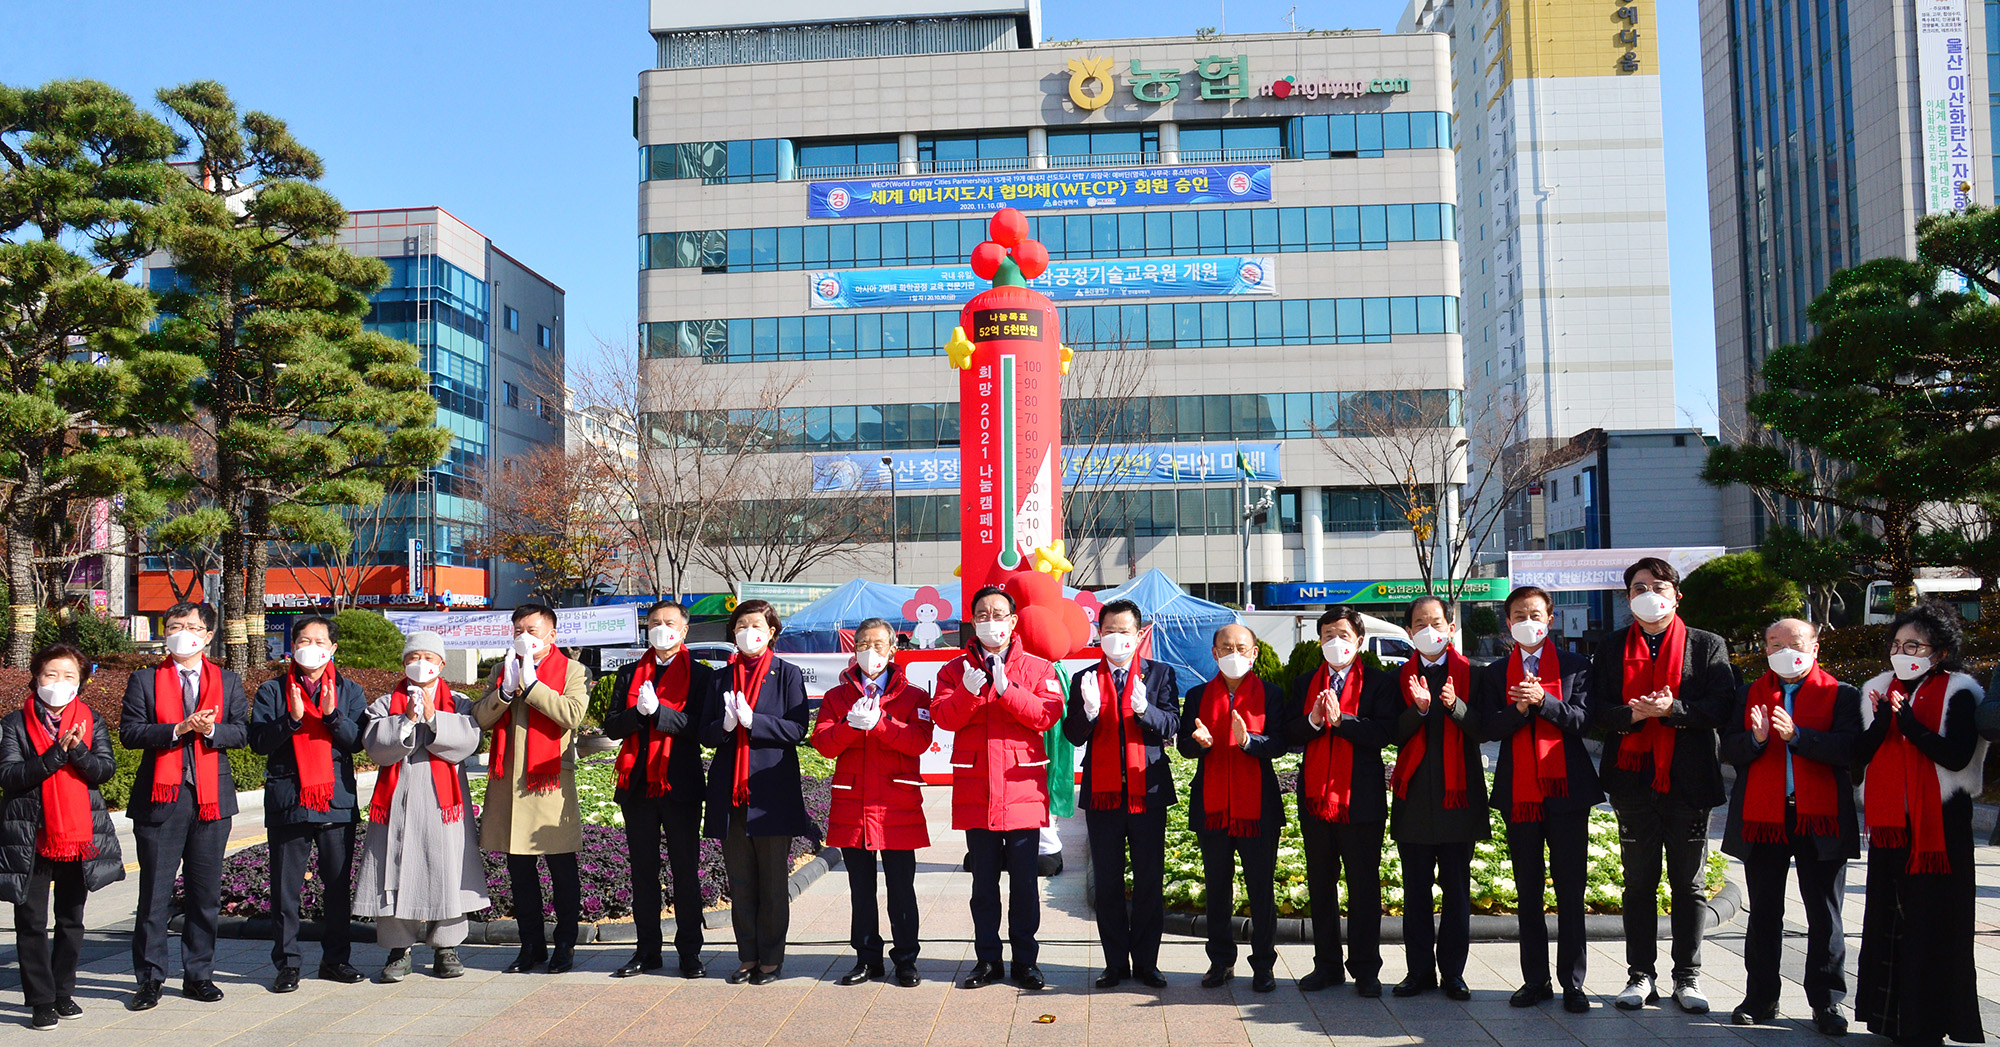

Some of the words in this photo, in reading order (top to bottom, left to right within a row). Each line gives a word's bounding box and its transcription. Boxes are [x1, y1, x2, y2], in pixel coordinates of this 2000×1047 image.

[1618, 0, 1641, 72] 예다음
[1946, 38, 1964, 71] 울산
[1129, 54, 1249, 102] 농협
[1936, 99, 1947, 121] 세계
[1926, 100, 1935, 142] 이산화탄소
[1948, 75, 1968, 158] 이산화탄소
[1937, 125, 1948, 147] 환경
[1939, 150, 1949, 172] 규제
[911, 179, 933, 187] Energy
[952, 177, 992, 186] Partnership):
[1233, 176, 1246, 190] 축
[870, 189, 903, 205] 세계
[909, 185, 993, 203] 에너지도시
[1000, 180, 1127, 200] 협의체(WECP)
[1134, 178, 1169, 194] 회원
[1175, 176, 1209, 193] 승인
[832, 193, 845, 207] 경
[941, 271, 956, 279] 국내
[1022, 263, 1177, 287] 학공정기술교육원
[1183, 262, 1218, 282] 개원
[855, 285, 877, 293] 아시아
[879, 284, 897, 292] 2번째
[899, 283, 928, 292] 화학공정
[929, 282, 944, 290] 교육
[946, 281, 975, 290] 전문기관
[990, 312, 1028, 322] 나눔목표
[979, 325, 1000, 337] 52억
[1003, 324, 1039, 337] 5천만원
[1024, 361, 1042, 373] 100
[979, 365, 992, 397] 희망
[1024, 378, 1038, 389] 90
[1024, 395, 1038, 407] 80
[1025, 413, 1038, 425] 70
[980, 403, 990, 459] 2021
[1025, 431, 1038, 442] 60
[1025, 448, 1038, 459] 50
[1157, 452, 1214, 475] 우리의
[1025, 466, 1038, 477] 40
[1026, 483, 1039, 494] 30
[979, 464, 993, 544] 나눔캠페인
[1026, 501, 1039, 512] 20
[1026, 518, 1039, 529] 10
[1026, 536, 1033, 547] 0
[1299, 587, 1328, 598] NH
[801, 667, 815, 675] 021
[803, 675, 817, 684] 페인
